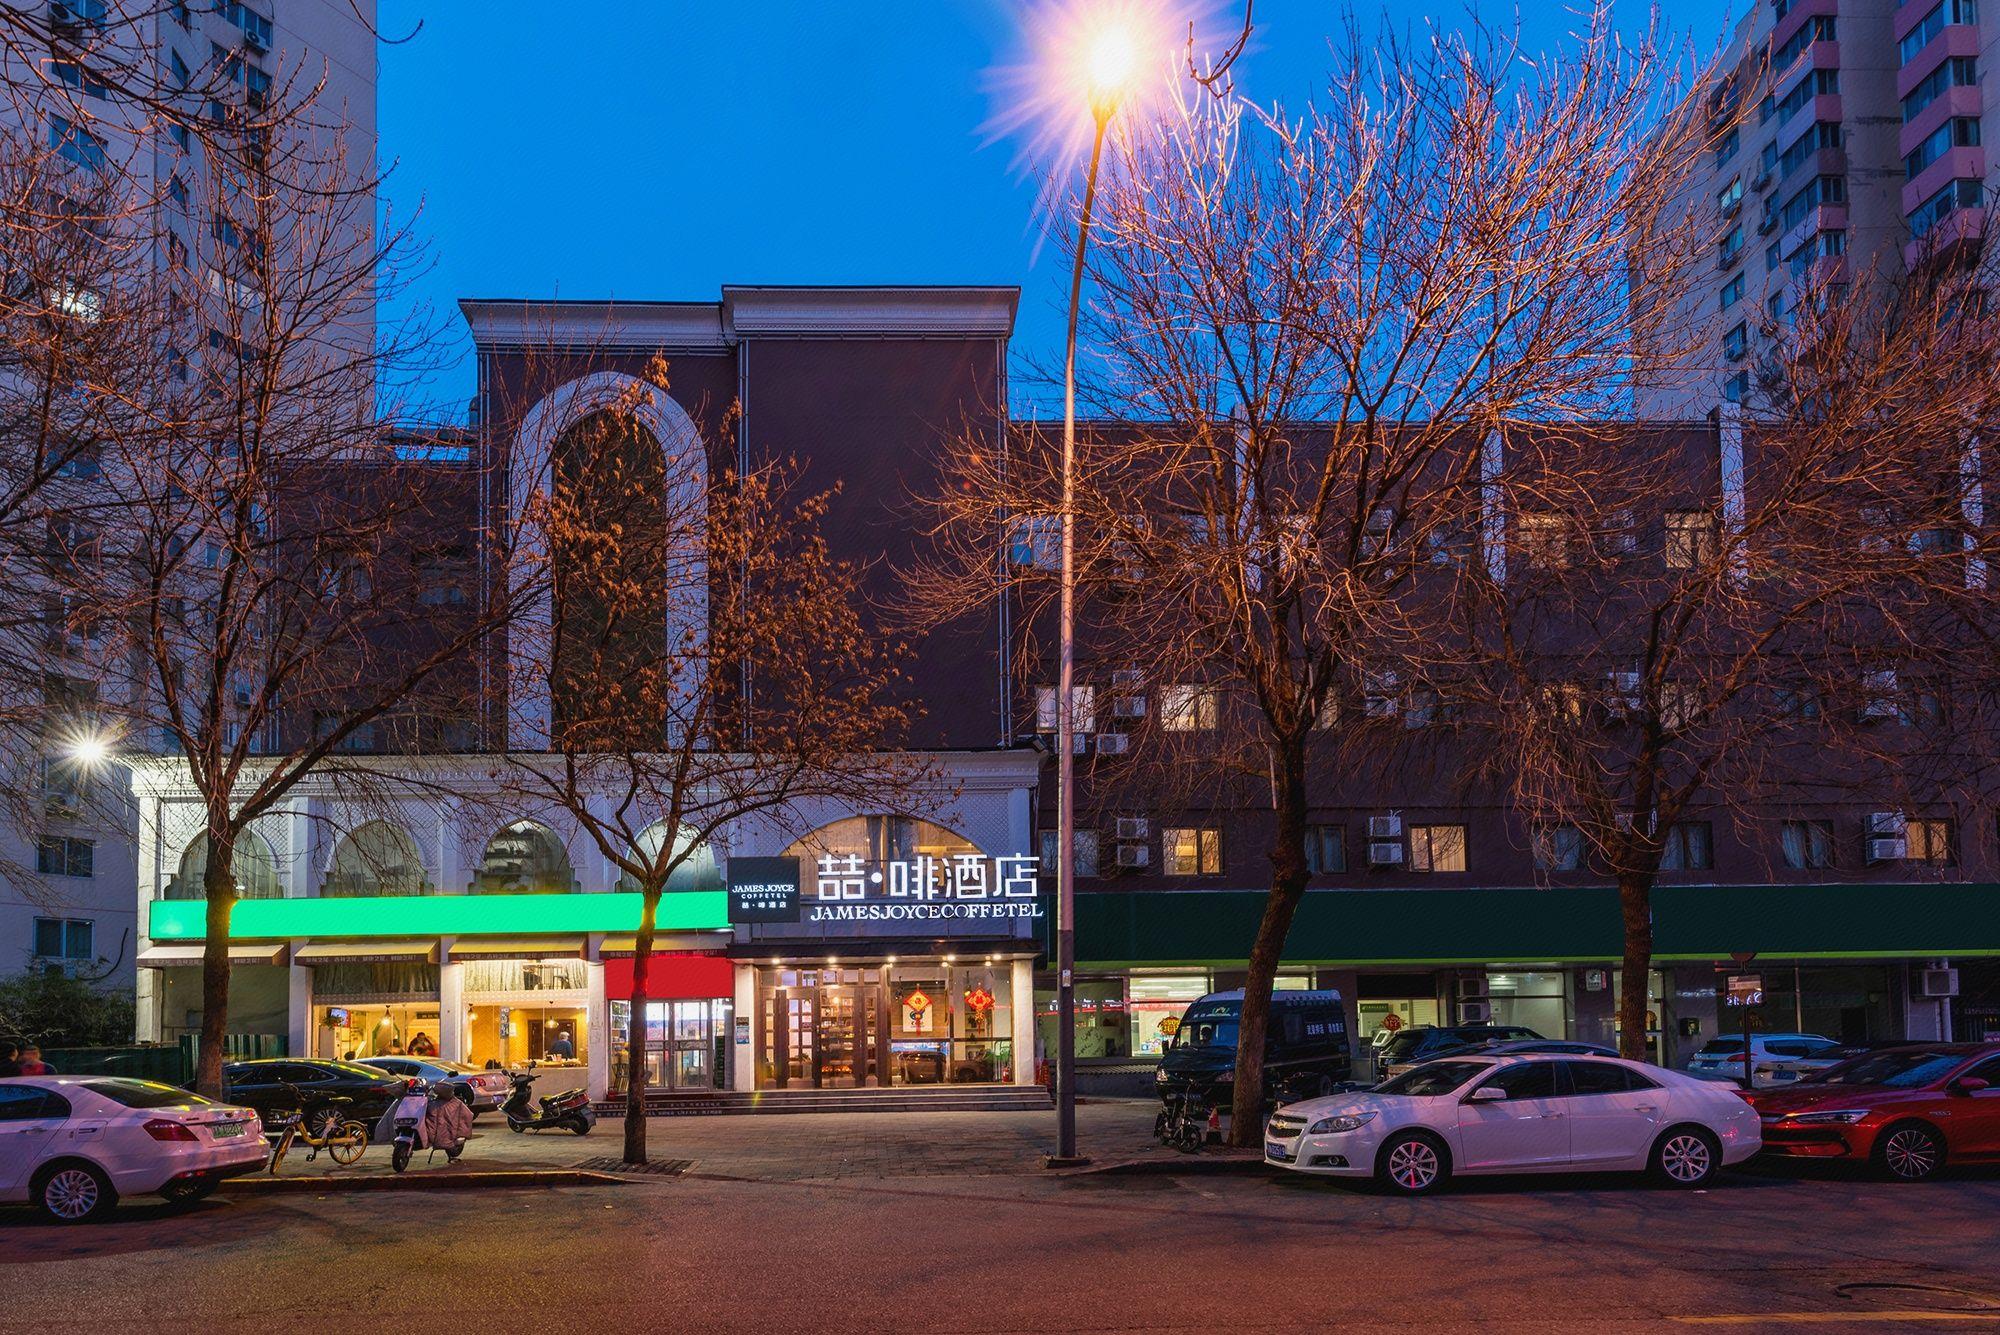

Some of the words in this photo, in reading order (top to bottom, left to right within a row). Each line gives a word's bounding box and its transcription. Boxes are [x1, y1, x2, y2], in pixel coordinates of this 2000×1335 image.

[817, 853, 1040, 900] 喆·啡酒店
[732, 884, 764, 893] JAMES
[764, 884, 795, 892] JOYCE
[811, 903, 1043, 920] JAMESJOYCECOFFETEL
